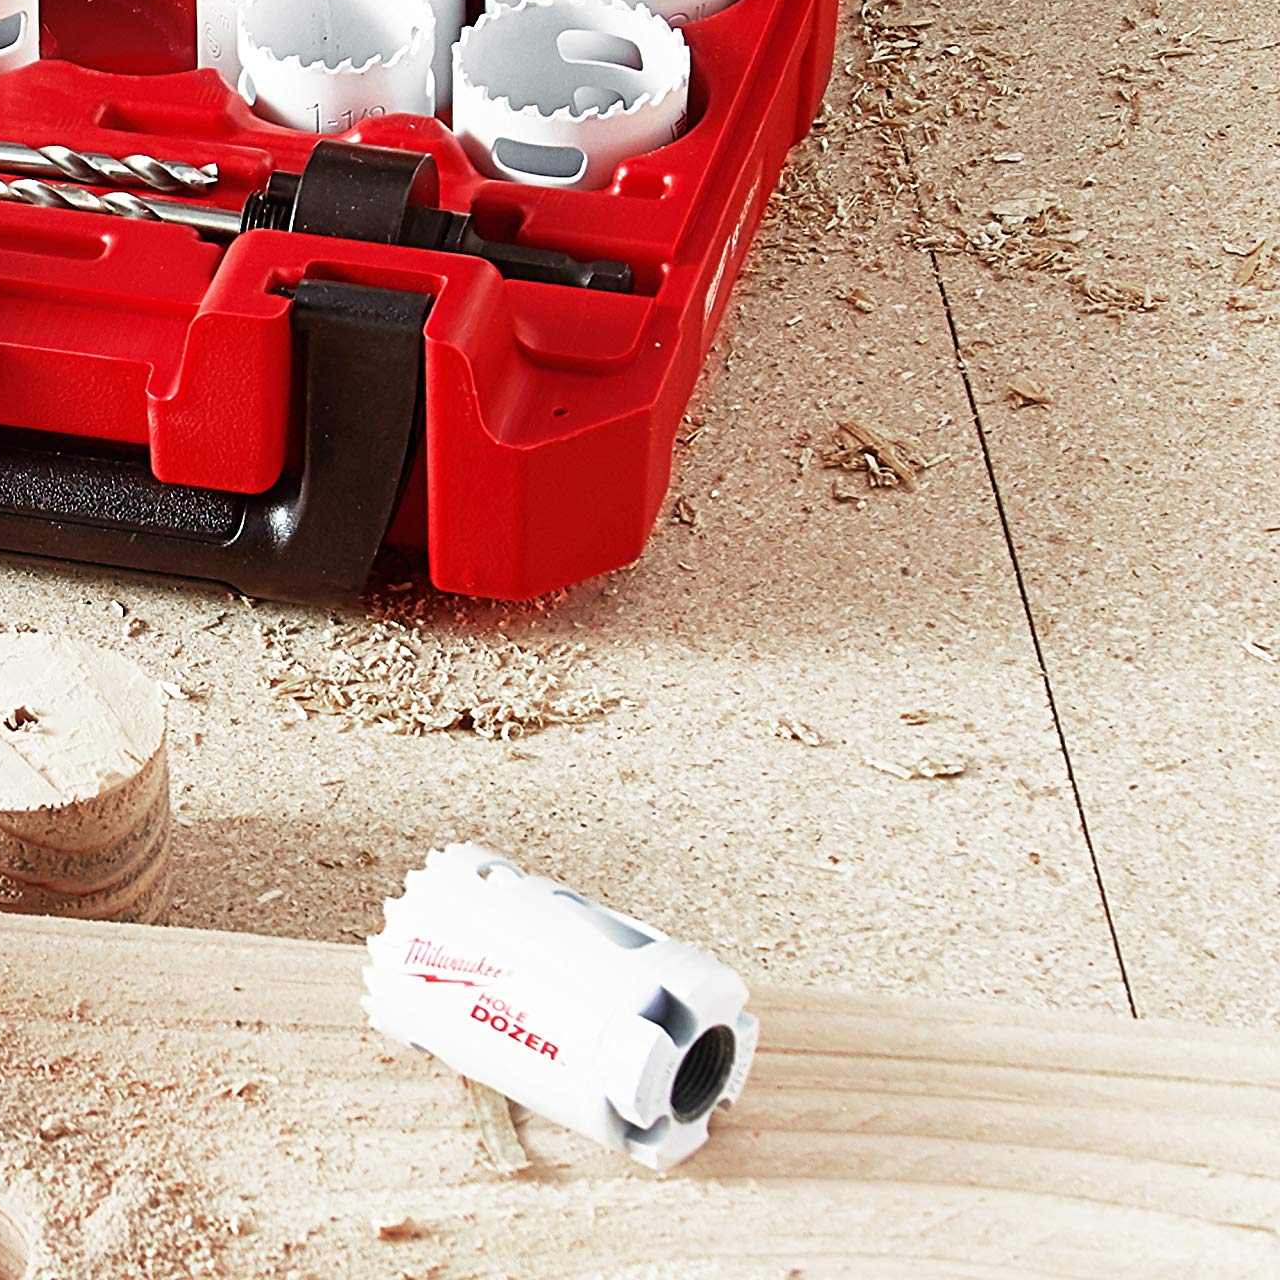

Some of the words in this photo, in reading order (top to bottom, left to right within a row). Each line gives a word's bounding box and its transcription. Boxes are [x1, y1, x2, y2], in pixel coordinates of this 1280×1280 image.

[404, 938, 502, 978] Milwaukee
[478, 992, 529, 1024] HOLE
[470, 1004, 559, 1060] DOZER
